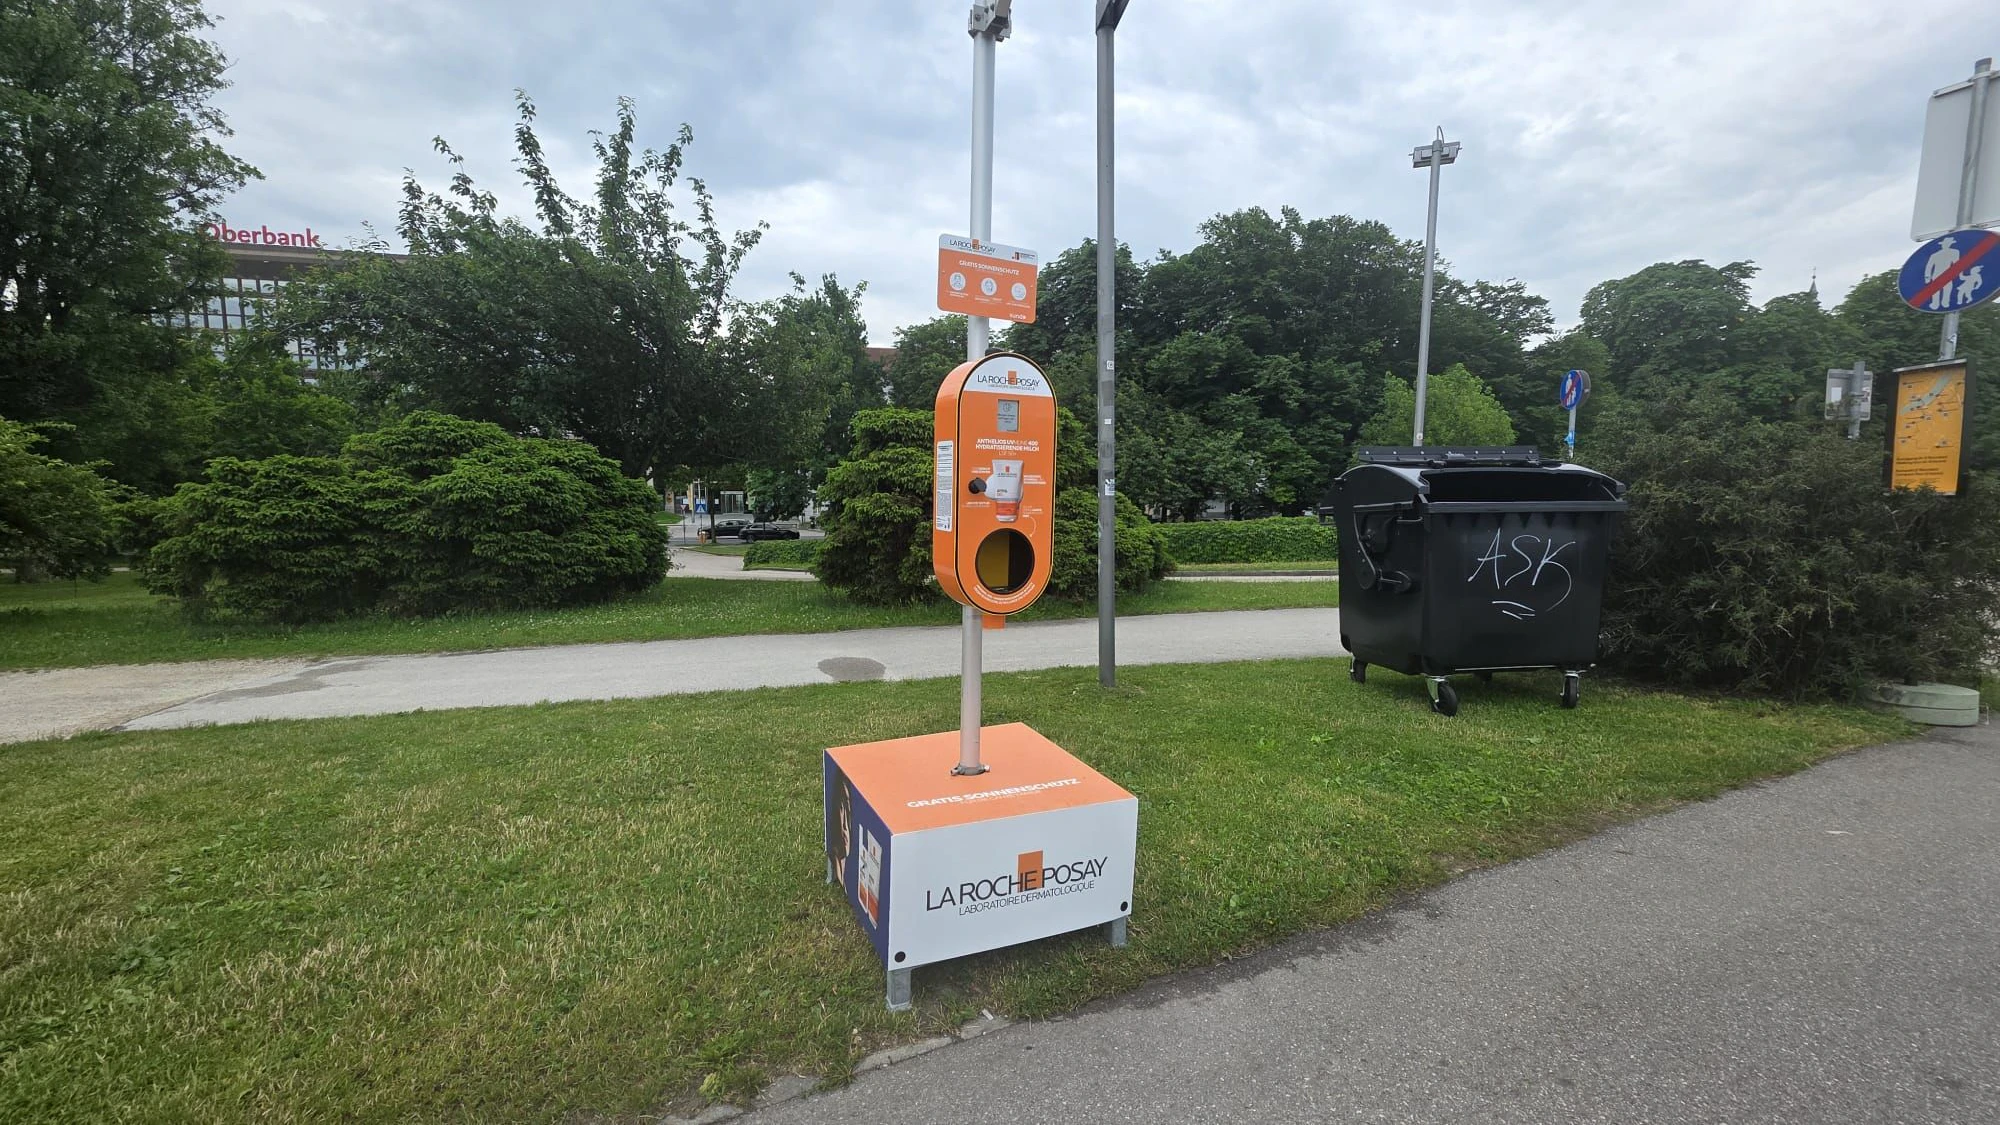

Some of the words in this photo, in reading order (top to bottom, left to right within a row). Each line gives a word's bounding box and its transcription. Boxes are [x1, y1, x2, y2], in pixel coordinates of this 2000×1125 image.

[203, 222, 321, 247] Oberbank
[977, 374, 987, 383] LA
[988, 375, 1016, 385] ROCHE
[1015, 377, 1040, 387] POSAY
[1468, 527, 1576, 612] ASK
[907, 794, 962, 808] GRATIS
[963, 778, 1081, 800] SONNENSCHUTZ
[926, 886, 956, 911] LA
[959, 870, 1038, 905] ROCHE
[1042, 856, 1108, 888] POSAY
[959, 895, 1020, 916] LABORATOIRE
[1020, 880, 1095, 904] DERMATOLOGIQUE
